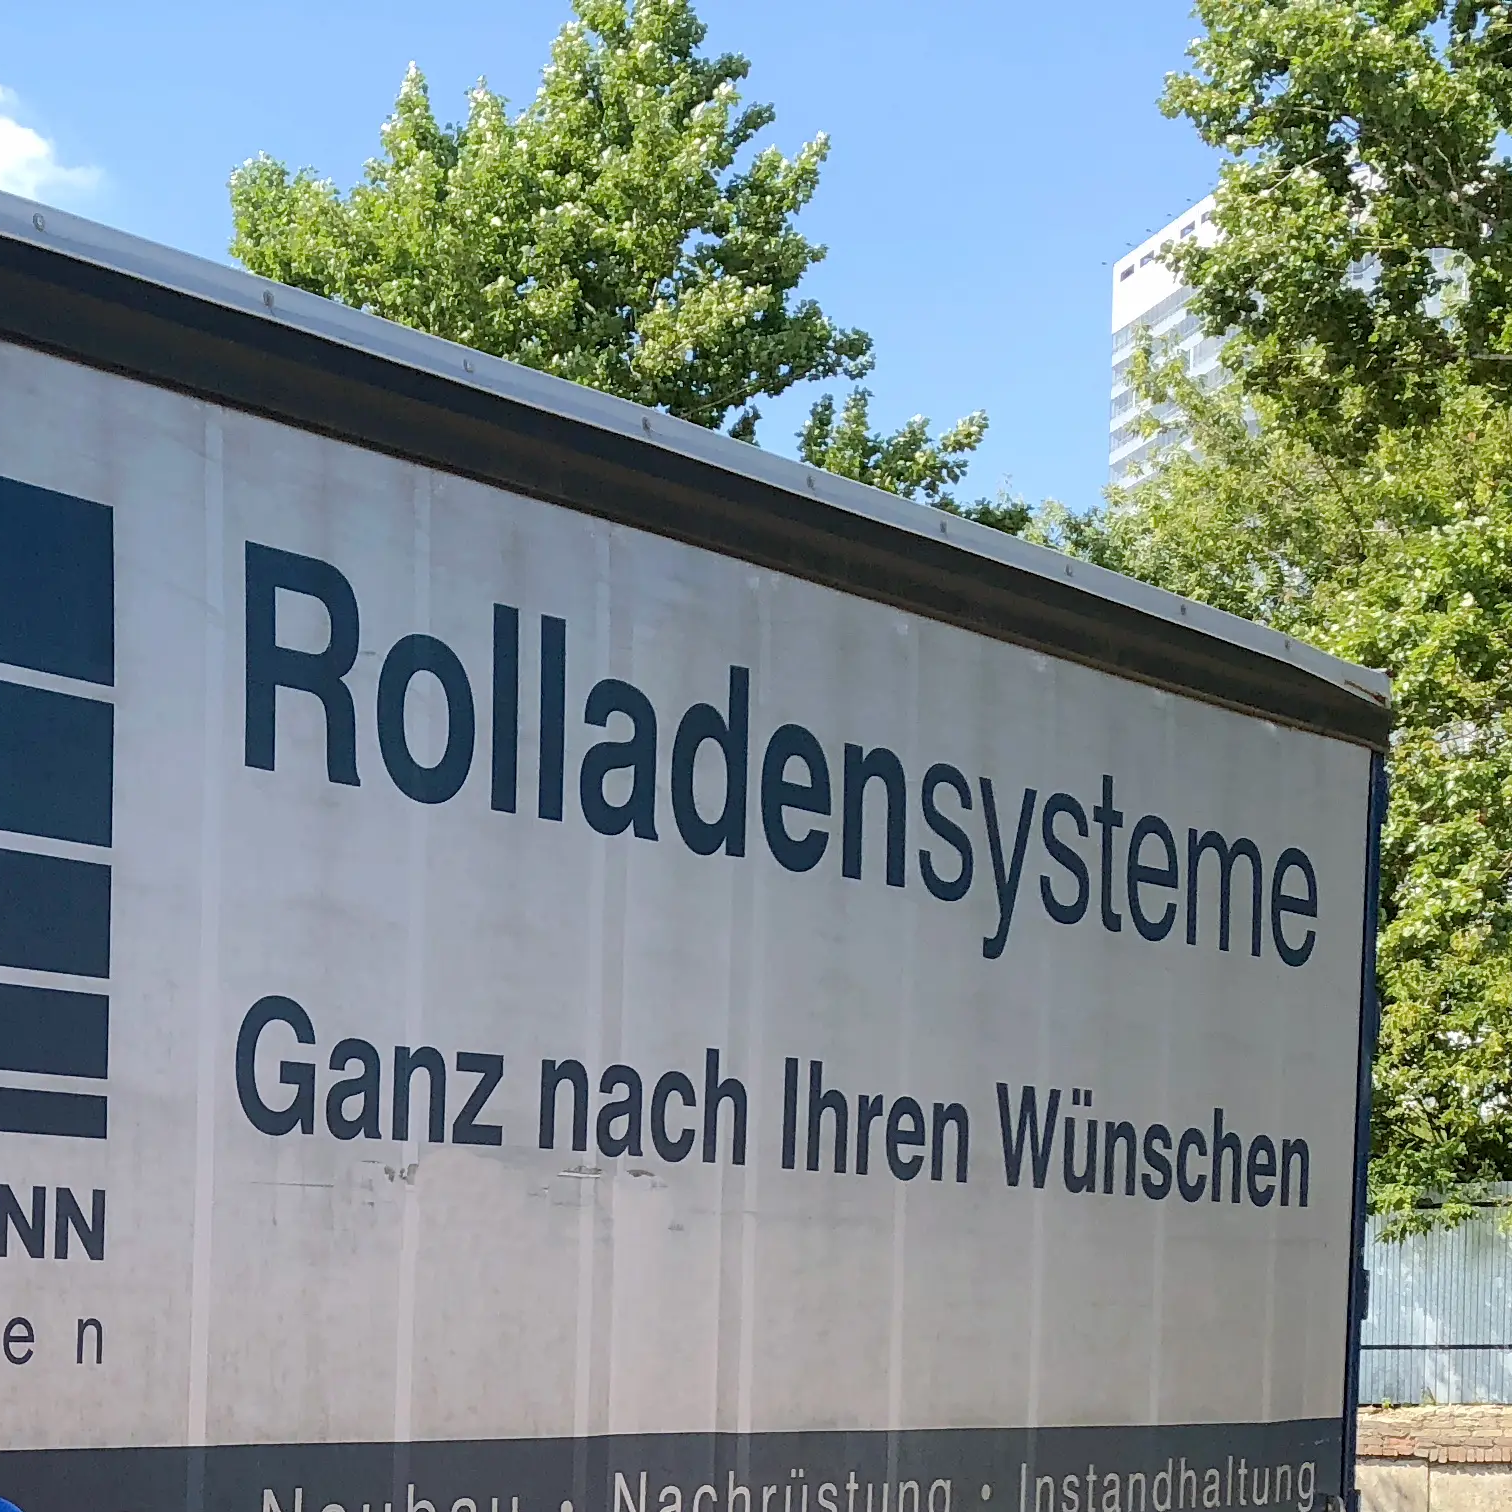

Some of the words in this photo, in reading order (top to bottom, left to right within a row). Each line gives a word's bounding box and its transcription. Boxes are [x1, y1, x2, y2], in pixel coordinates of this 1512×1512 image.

[244, 539, 1318, 968] Rolladensysteme
[235, 995, 505, 1147] Ganz
[538, 1047, 748, 1166] nach
[781, 1056, 969, 1184] Ihren
[995, 1082, 1310, 1208] Wünschen
